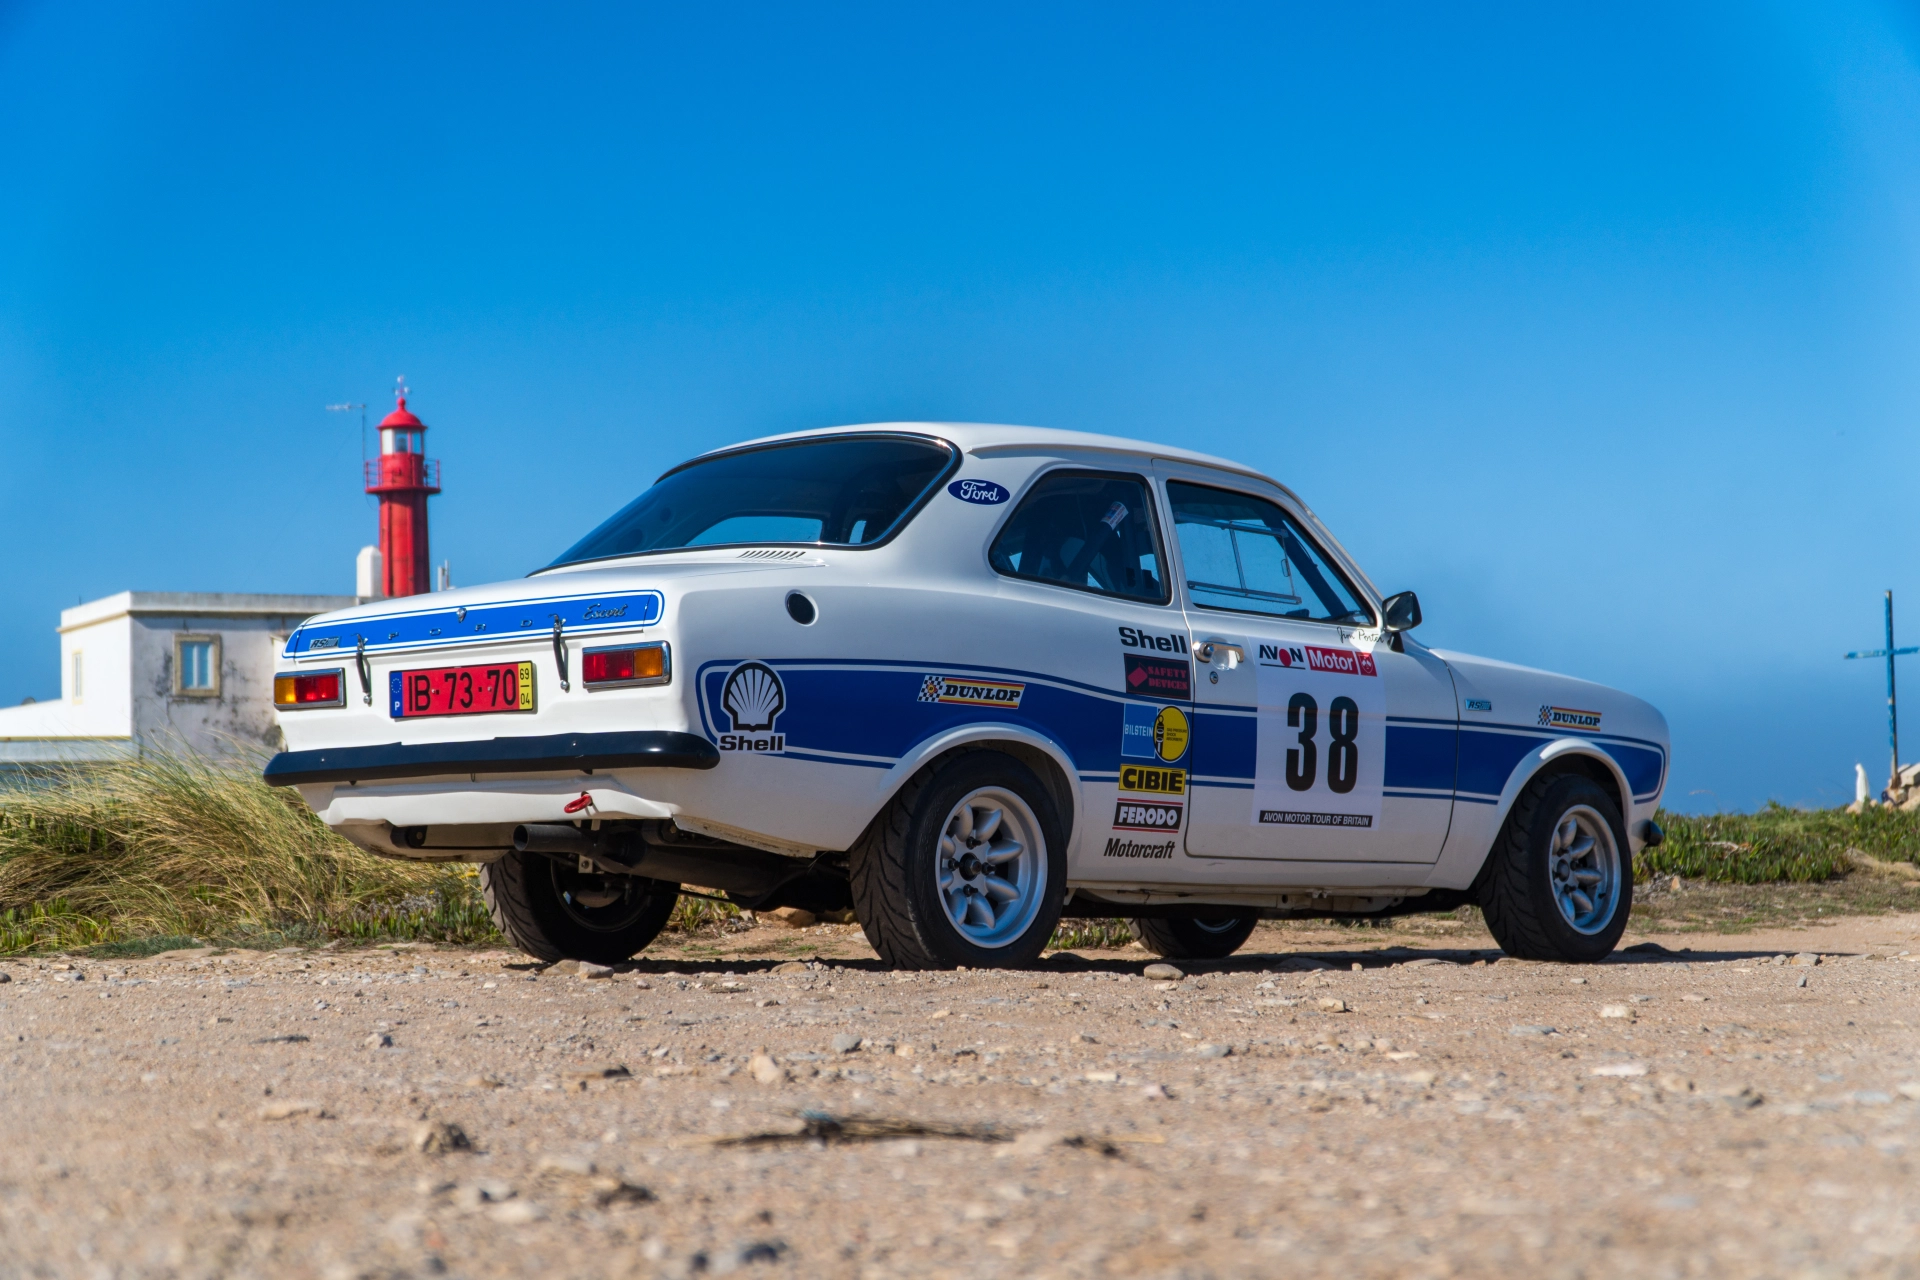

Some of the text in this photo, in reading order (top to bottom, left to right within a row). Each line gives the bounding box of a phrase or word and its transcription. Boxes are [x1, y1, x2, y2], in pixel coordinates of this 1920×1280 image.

[961, 481, 999, 501] Ford
[583, 603, 628, 620] Escort
[1118, 626, 1188, 654] Shell
[1308, 649, 1353, 671] Motor
[519, 667, 530, 680] 69
[1147, 666, 1187, 679] SAFETY
[1148, 677, 1188, 690] DEVICES
[520, 692, 531, 705] 04
[943, 684, 1021, 702] DUNLOP
[394, 701, 400, 711] P
[1552, 712, 1600, 726] DUNLOP
[1124, 724, 1154, 737] BILSTEIN
[719, 735, 783, 751] Shell
[1285, 692, 1359, 794] 38
[1118, 806, 1178, 826] FERODO
[1263, 812, 1370, 826] AVON MOTOR TOUR OF BRITAIN
[1103, 837, 1176, 859] Motorcraft
